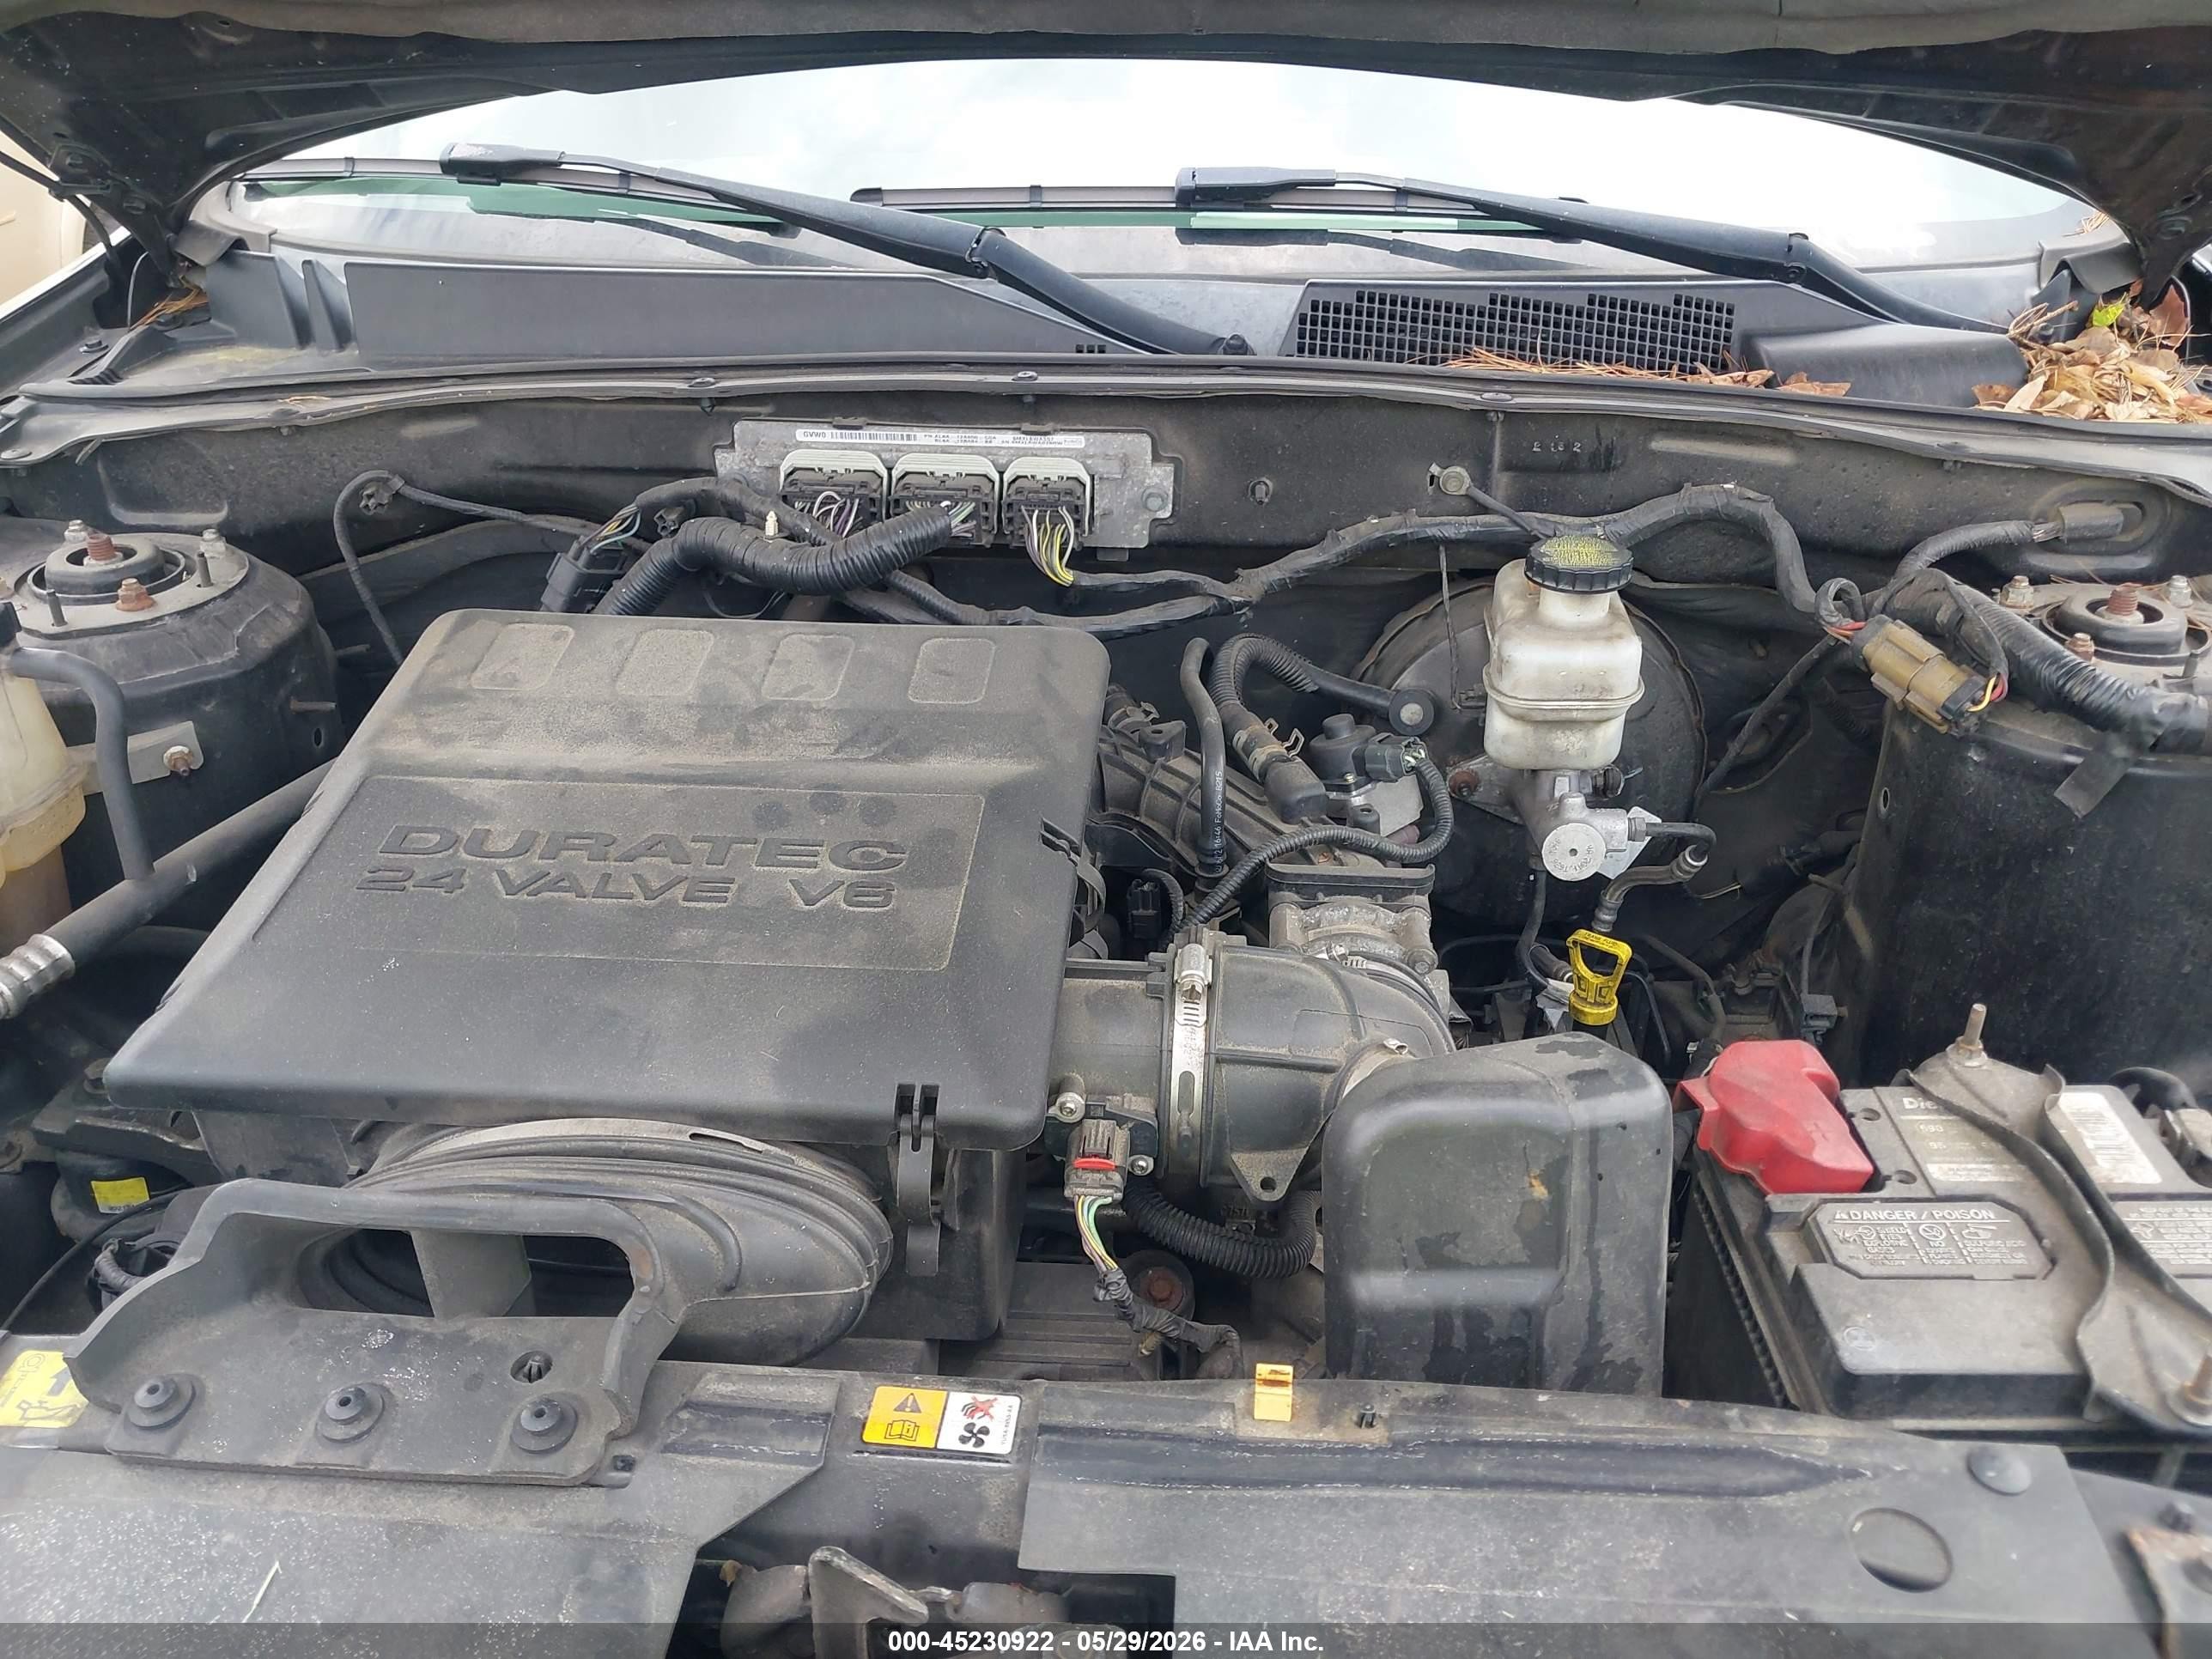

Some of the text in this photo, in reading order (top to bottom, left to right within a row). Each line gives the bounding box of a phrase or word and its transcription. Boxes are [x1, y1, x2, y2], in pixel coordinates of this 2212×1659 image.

[1214, 794, 1223, 823] FoMoCo
[378, 825, 908, 871] DURATEC
[355, 866, 896, 912] 24 VALVE V6
[1849, 1210, 1917, 1220] DANGER
[1931, 1209, 1996, 1219] POISON
